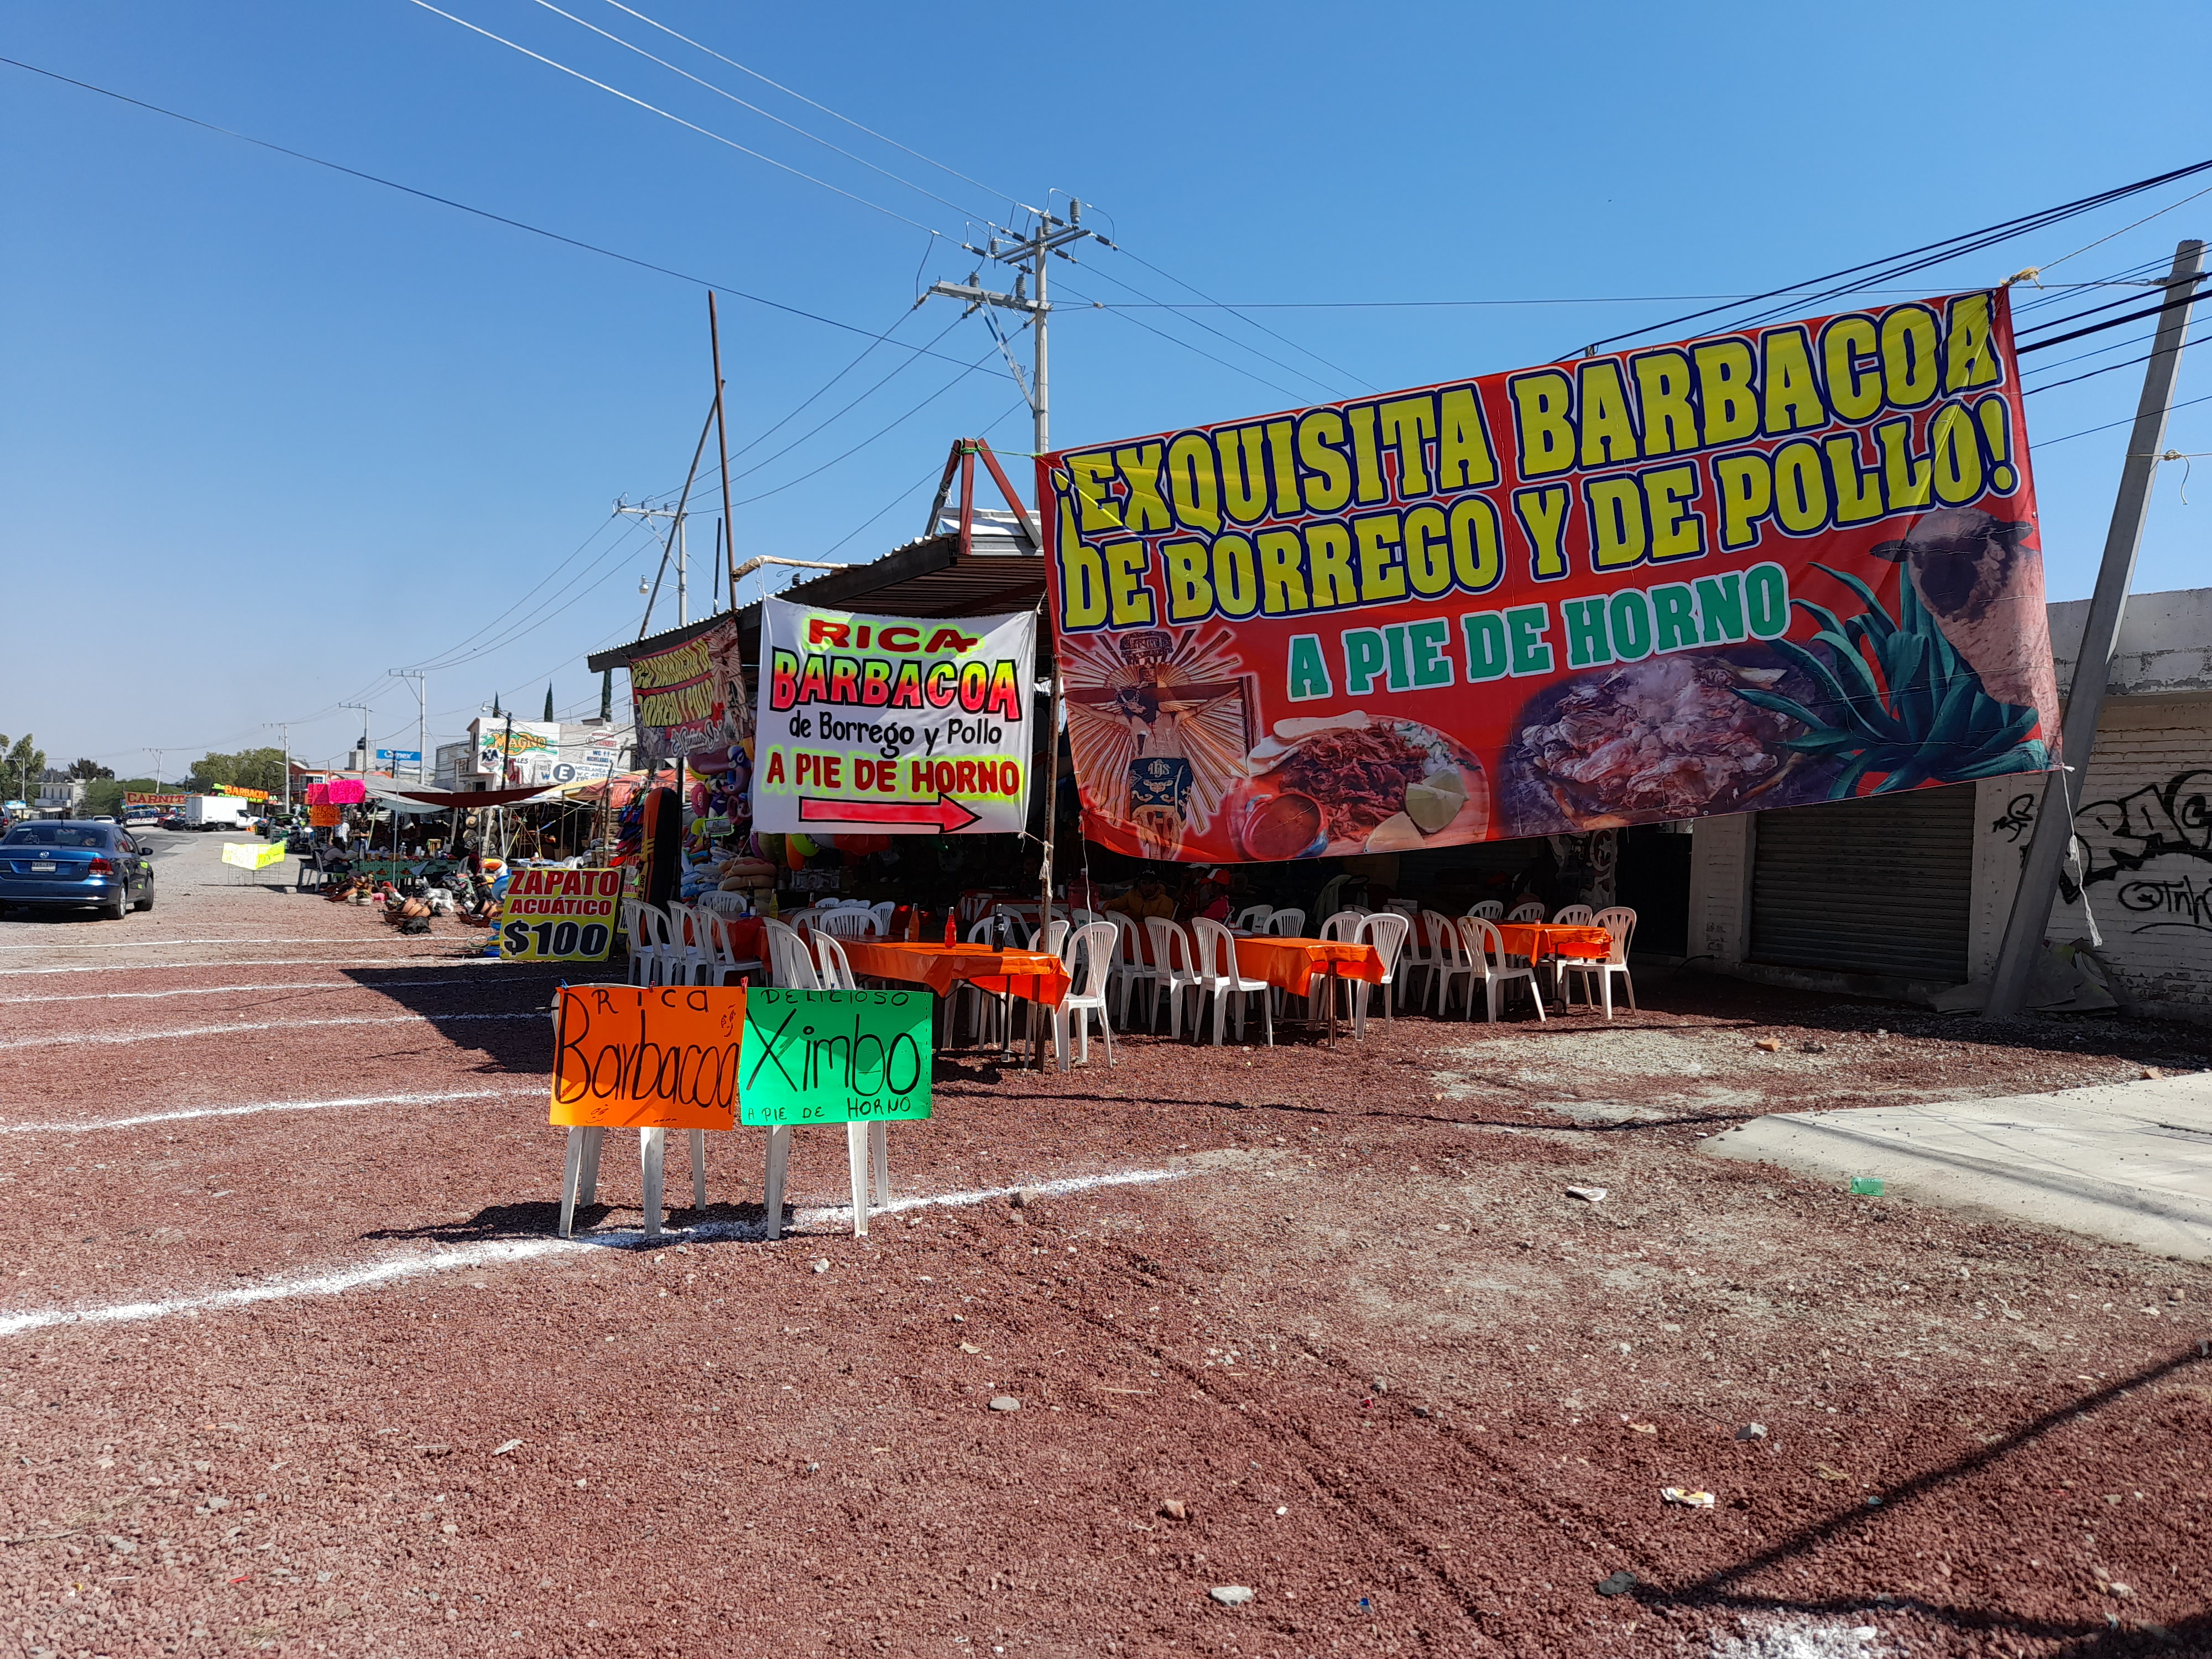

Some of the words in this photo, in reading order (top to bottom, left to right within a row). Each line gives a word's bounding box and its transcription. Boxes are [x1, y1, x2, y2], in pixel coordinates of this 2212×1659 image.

[1051, 383, 1499, 538] ¡EXQUISITA
[1509, 290, 2002, 480] BARBACOA
[1058, 538, 1156, 633] DE
[1161, 495, 1505, 625] BORREGO
[1515, 483, 1571, 580] Y
[1583, 459, 1708, 573] DE
[1714, 394, 2019, 552] POLLO!
[808, 619, 978, 653] RICA
[1288, 634, 1332, 702] A
[1342, 617, 1454, 695] PIE
[1462, 604, 1552, 683] DE
[1563, 561, 1788, 670] HORNO
[770, 646, 1022, 722] BARBACOA
[789, 710, 811, 738] de
[820, 711, 914, 759] Borrego
[924, 727, 940, 757] y
[947, 718, 1003, 745] Pollo
[558, 765, 570, 780] E
[766, 752, 785, 785] A
[796, 753, 841, 789] PIE
[854, 758, 898, 792] DE
[911, 760, 1020, 796] HORNO
[127, 792, 186, 804] CARNIT
[225, 785, 269, 800] BARBACOA
[508, 870, 619, 897] ZAPATO
[509, 896, 612, 916] ACUÁTICO
[504, 920, 609, 956] $100
[760, 989, 910, 1006] DELICIOSO
[554, 991, 740, 1115] Barbacoa
[745, 1007, 921, 1097] Ximbo
[748, 1108, 755, 1120] A
[761, 1107, 787, 1121] PIE
[802, 1106, 826, 1119] DE
[847, 1096, 911, 1120] HORNO
